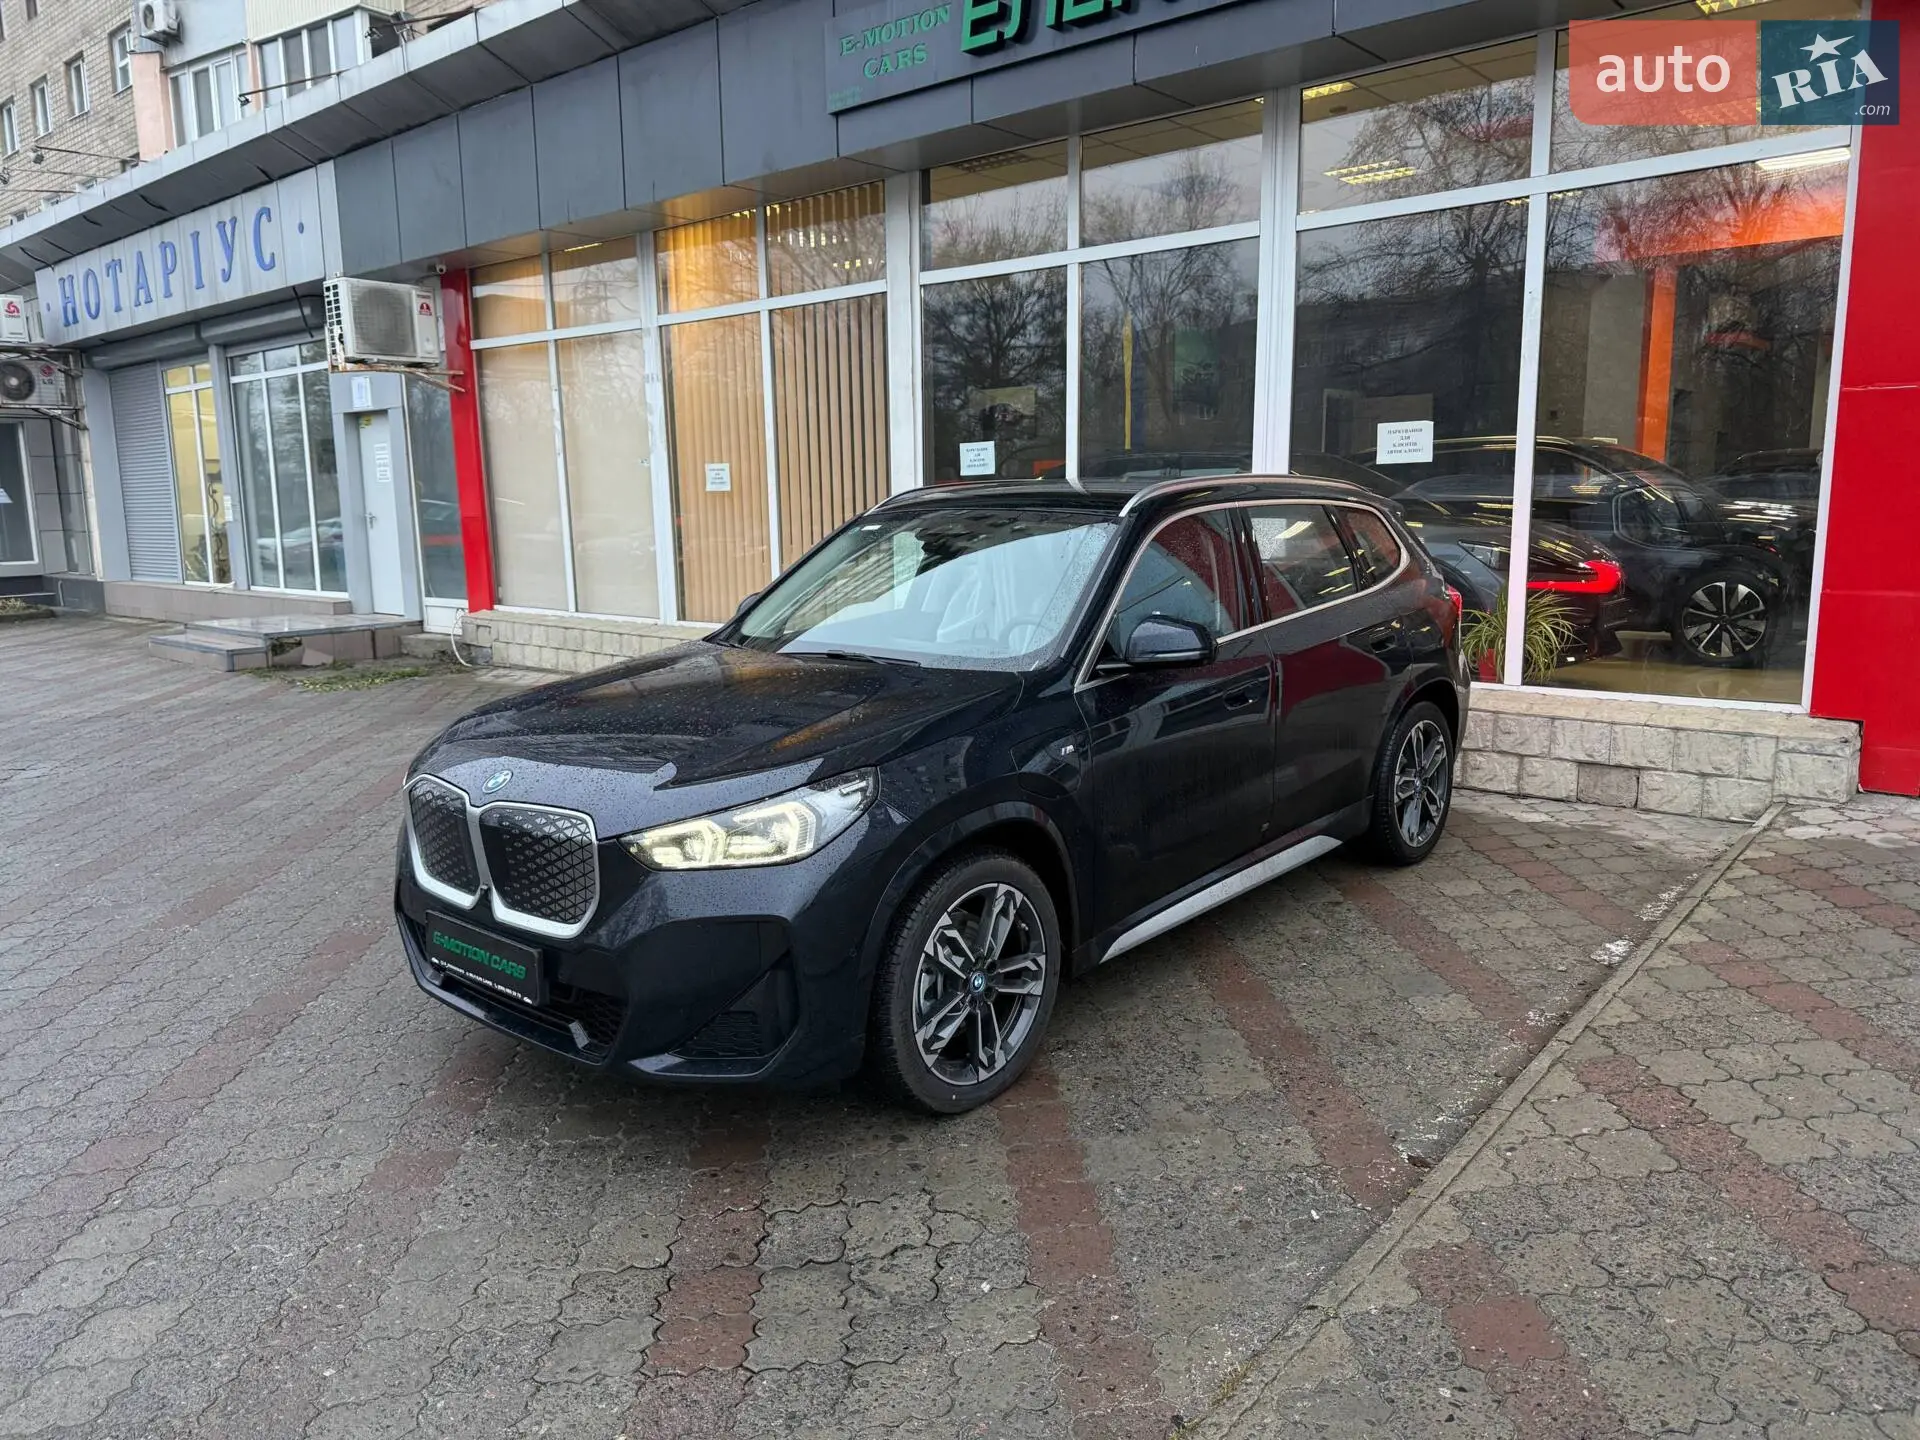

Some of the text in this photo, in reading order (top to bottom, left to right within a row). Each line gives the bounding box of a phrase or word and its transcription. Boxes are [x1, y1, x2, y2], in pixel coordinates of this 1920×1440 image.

[840, 3, 951, 56] E-MOTION
[863, 41, 928, 79] CARS
[58, 206, 277, 327] НОТАРІУС
[432, 931, 490, 965] E-MOTION
[490, 954, 527, 980] CARS
